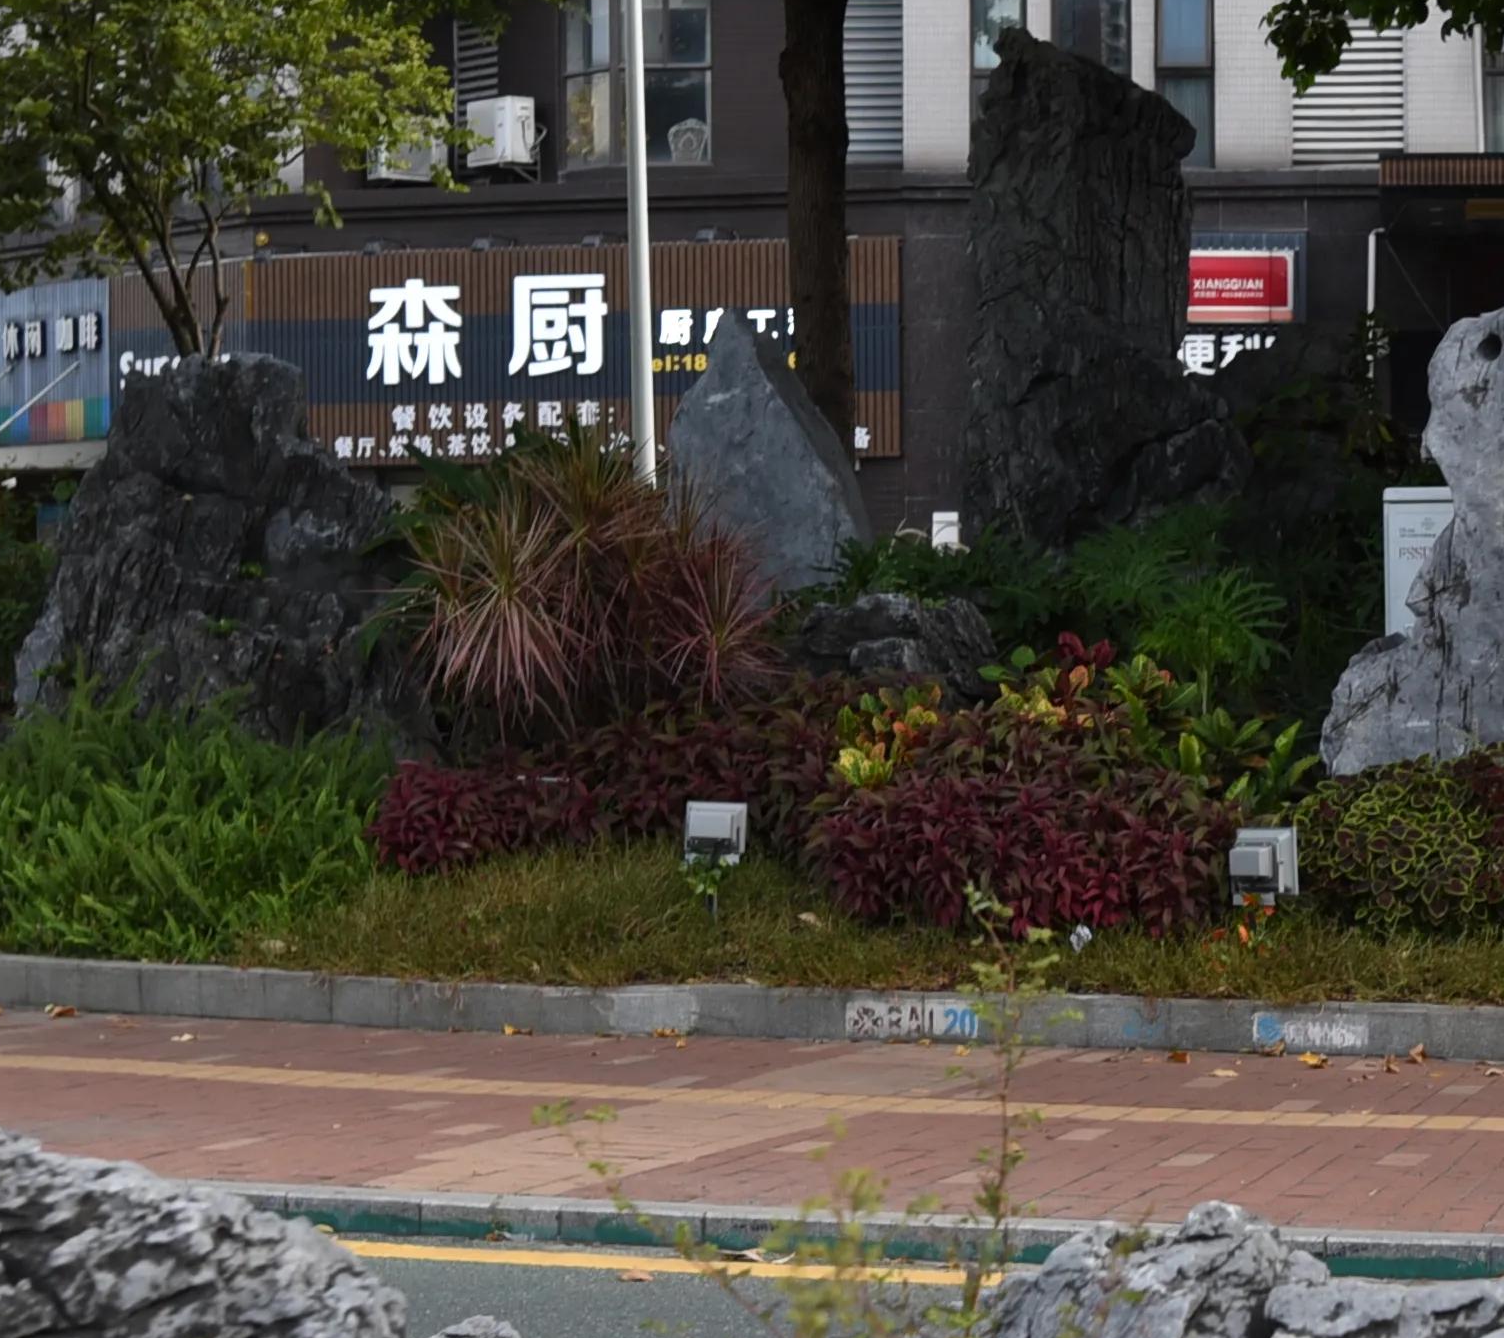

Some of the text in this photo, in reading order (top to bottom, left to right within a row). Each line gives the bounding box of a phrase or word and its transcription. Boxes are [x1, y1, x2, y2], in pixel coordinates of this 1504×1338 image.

[1, 320, 43, 360] 休闲
[55, 311, 99, 353] 咖啡
[366, 273, 608, 386] 森厨
